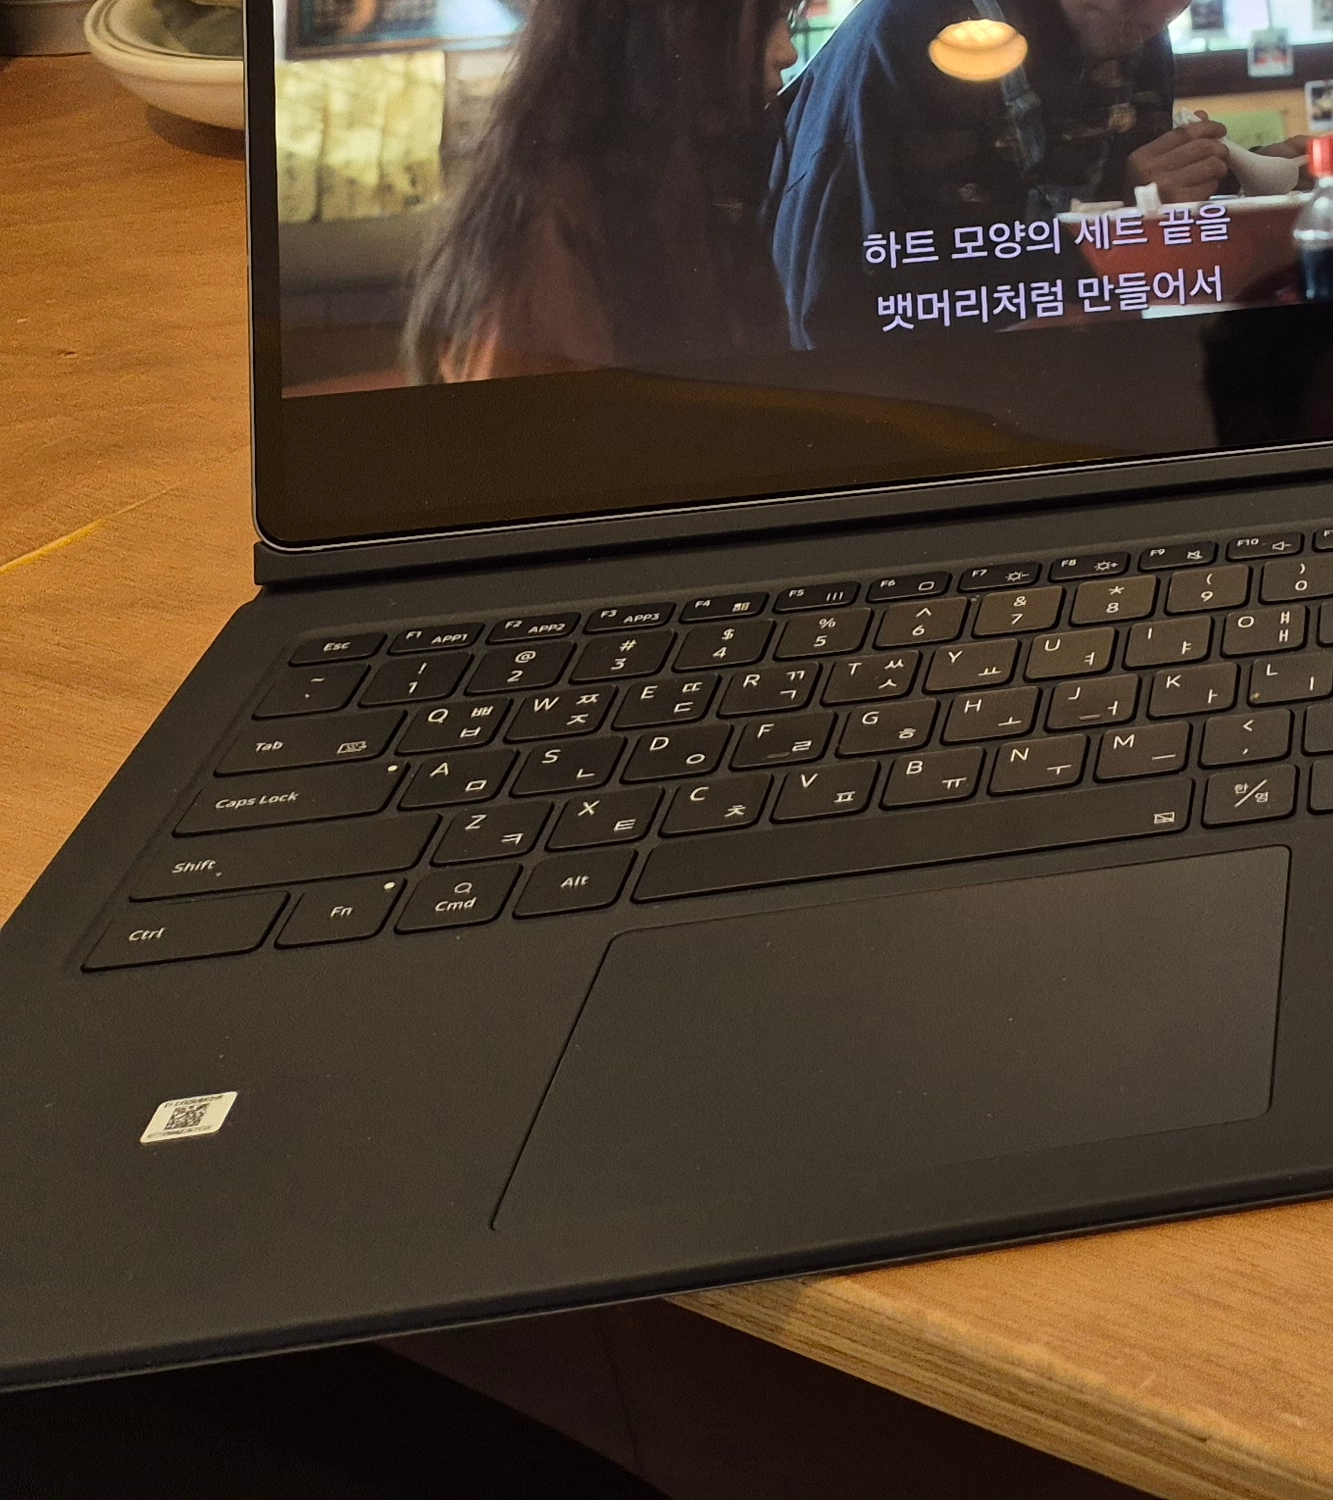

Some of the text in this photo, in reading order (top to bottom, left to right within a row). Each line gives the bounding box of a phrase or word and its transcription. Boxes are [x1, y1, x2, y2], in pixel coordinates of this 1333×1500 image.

[862, 203, 1232, 269] 하트 모양의 세트 끝을
[876, 265, 1223, 332] 뱃머리처럼 만들어서
[1236, 537, 1259, 546] F10
[1149, 548, 1165, 556] F9
[1061, 559, 1076, 567] F8
[971, 569, 987, 577] F7
[880, 579, 895, 587] F6
[1294, 580, 1307, 590] 0
[788, 588, 804, 597] F5
[1200, 590, 1213, 601] 9
[694, 599, 710, 607] F4
[1013, 595, 1026, 606] &
[600, 609, 617, 618] F3
[1105, 602, 1118, 613] 8
[623, 612, 659, 627] APP3
[819, 617, 835, 628] %
[1011, 613, 1022, 624] 7
[1237, 615, 1254, 627] O
[1280, 610, 1289, 623] ㅒ
[504, 620, 522, 628] F2
[528, 623, 565, 637] APP2
[912, 624, 924, 635] 6
[405, 630, 421, 639] F1
[431, 633, 467, 643] APP1
[721, 628, 734, 640] $
[1278, 628, 1288, 642] ㅐ
[323, 641, 350, 651] Esc
[619, 639, 636, 651] #
[813, 635, 826, 646] 5
[1044, 638, 1060, 651] U
[712, 646, 726, 657] 4
[1181, 640, 1191, 654] ㅑ
[514, 650, 536, 663] @
[948, 650, 962, 663] Y
[1084, 651, 1094, 665] ㅕ
[610, 657, 626, 669] 3
[848, 662, 862, 674] T
[884, 658, 903, 669] ㅆ
[1266, 663, 1277, 675] L
[506, 670, 522, 682] 2
[786, 670, 805, 680] ㄲ
[978, 666, 1000, 675] ㅛ
[682, 681, 702, 692] ㄸ
[742, 674, 760, 687] R
[878, 678, 896, 688] ㅅ
[1166, 675, 1180, 688] K
[408, 681, 417, 693] 1
[640, 685, 658, 699] E
[1067, 686, 1080, 699] J
[575, 693, 599, 704] ㅉ
[780, 689, 796, 699] ㄱ
[1207, 689, 1217, 703] ㅏ
[533, 696, 559, 711] W
[673, 701, 693, 712] ㄷ
[964, 698, 981, 713] H
[1107, 700, 1118, 715] ㅓ
[427, 708, 448, 723] Q
[470, 705, 493, 717] ㅃ
[566, 713, 588, 725] ㅈ
[861, 711, 879, 724] G
[997, 716, 1021, 726] ㅗ
[459, 726, 480, 737] ㅂ
[757, 723, 774, 737] F
[898, 727, 916, 738] ㅎ
[255, 740, 282, 751] Tab
[649, 736, 669, 750] D
[791, 740, 811, 751] ㄹ
[1113, 734, 1134, 749] M
[541, 748, 560, 763] S
[685, 753, 705, 764] ㅇ
[1010, 747, 1028, 762] N
[429, 762, 448, 776] A
[576, 768, 594, 778] ㄴ
[905, 760, 922, 774] B
[1046, 764, 1071, 774] ㅜ
[465, 779, 486, 791] ㅁ
[800, 773, 817, 787] V
[941, 777, 966, 788] ㅠ
[689, 786, 708, 801] C
[834, 790, 855, 802] ㅍ
[215, 791, 298, 809] Caps Lock
[577, 800, 599, 816] X
[724, 804, 745, 817] ㅊ
[464, 814, 486, 830] Z
[613, 818, 635, 831] ㅌ
[501, 832, 523, 844] ㅋ
[171, 859, 218, 874] Shift
[560, 875, 588, 887] Alt
[434, 896, 476, 911] Cmd
[330, 905, 352, 917] Fn
[128, 927, 164, 940] Ctrl
